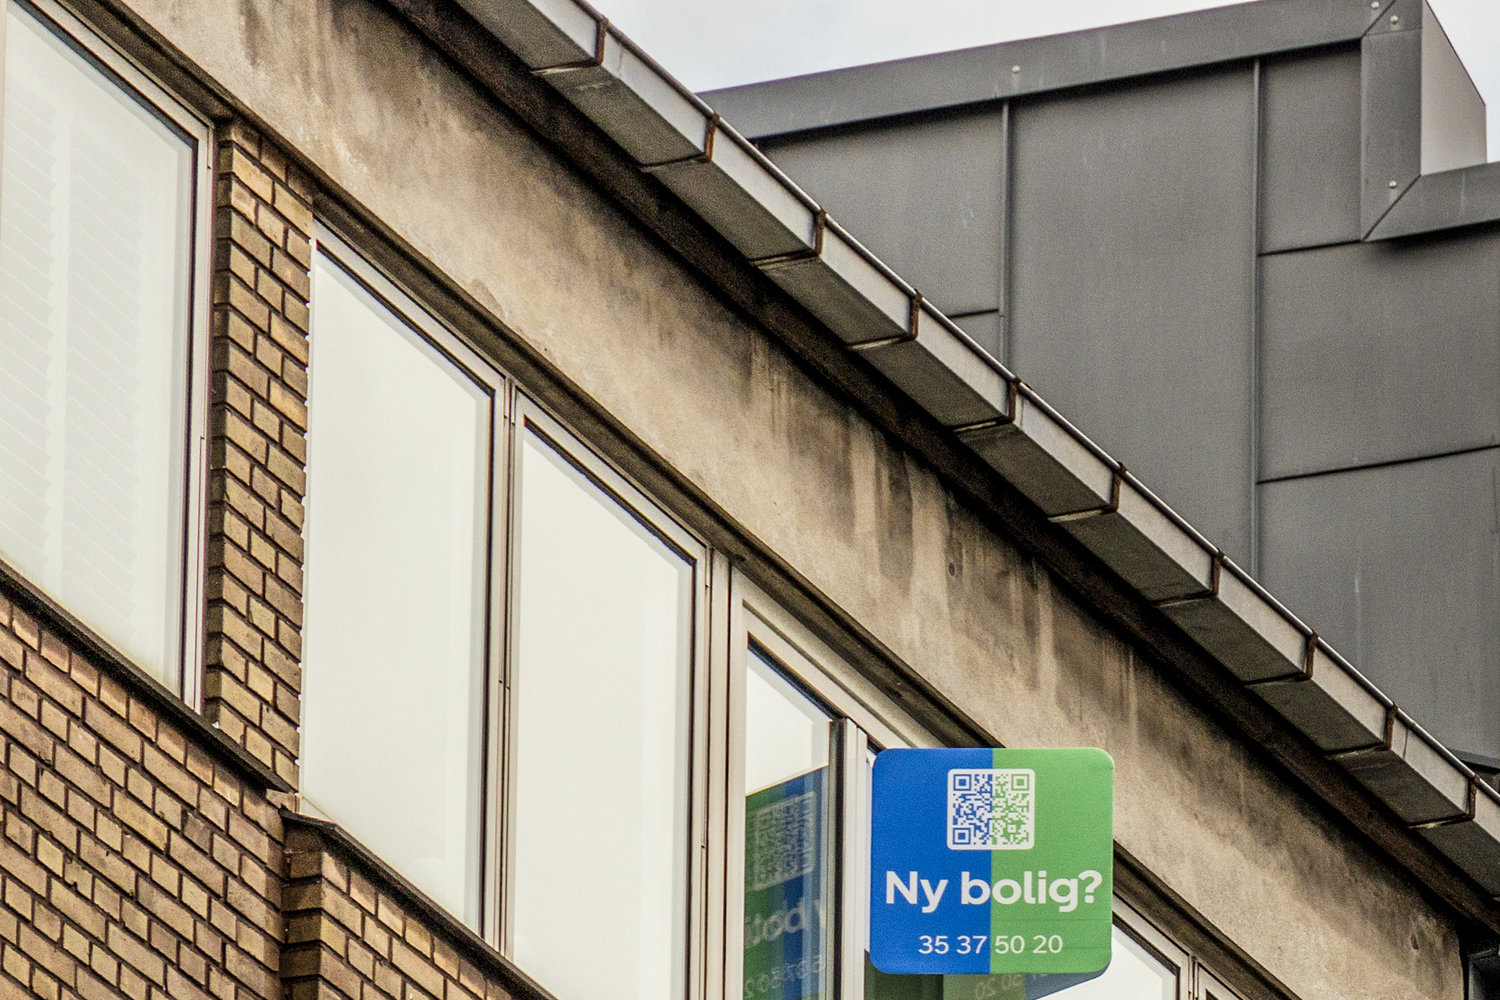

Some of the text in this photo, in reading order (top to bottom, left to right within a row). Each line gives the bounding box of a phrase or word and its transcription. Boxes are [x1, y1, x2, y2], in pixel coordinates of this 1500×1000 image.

[885, 869, 1104, 914] Ny bolig?
[918, 934, 1064, 955] 35 37 50 20
